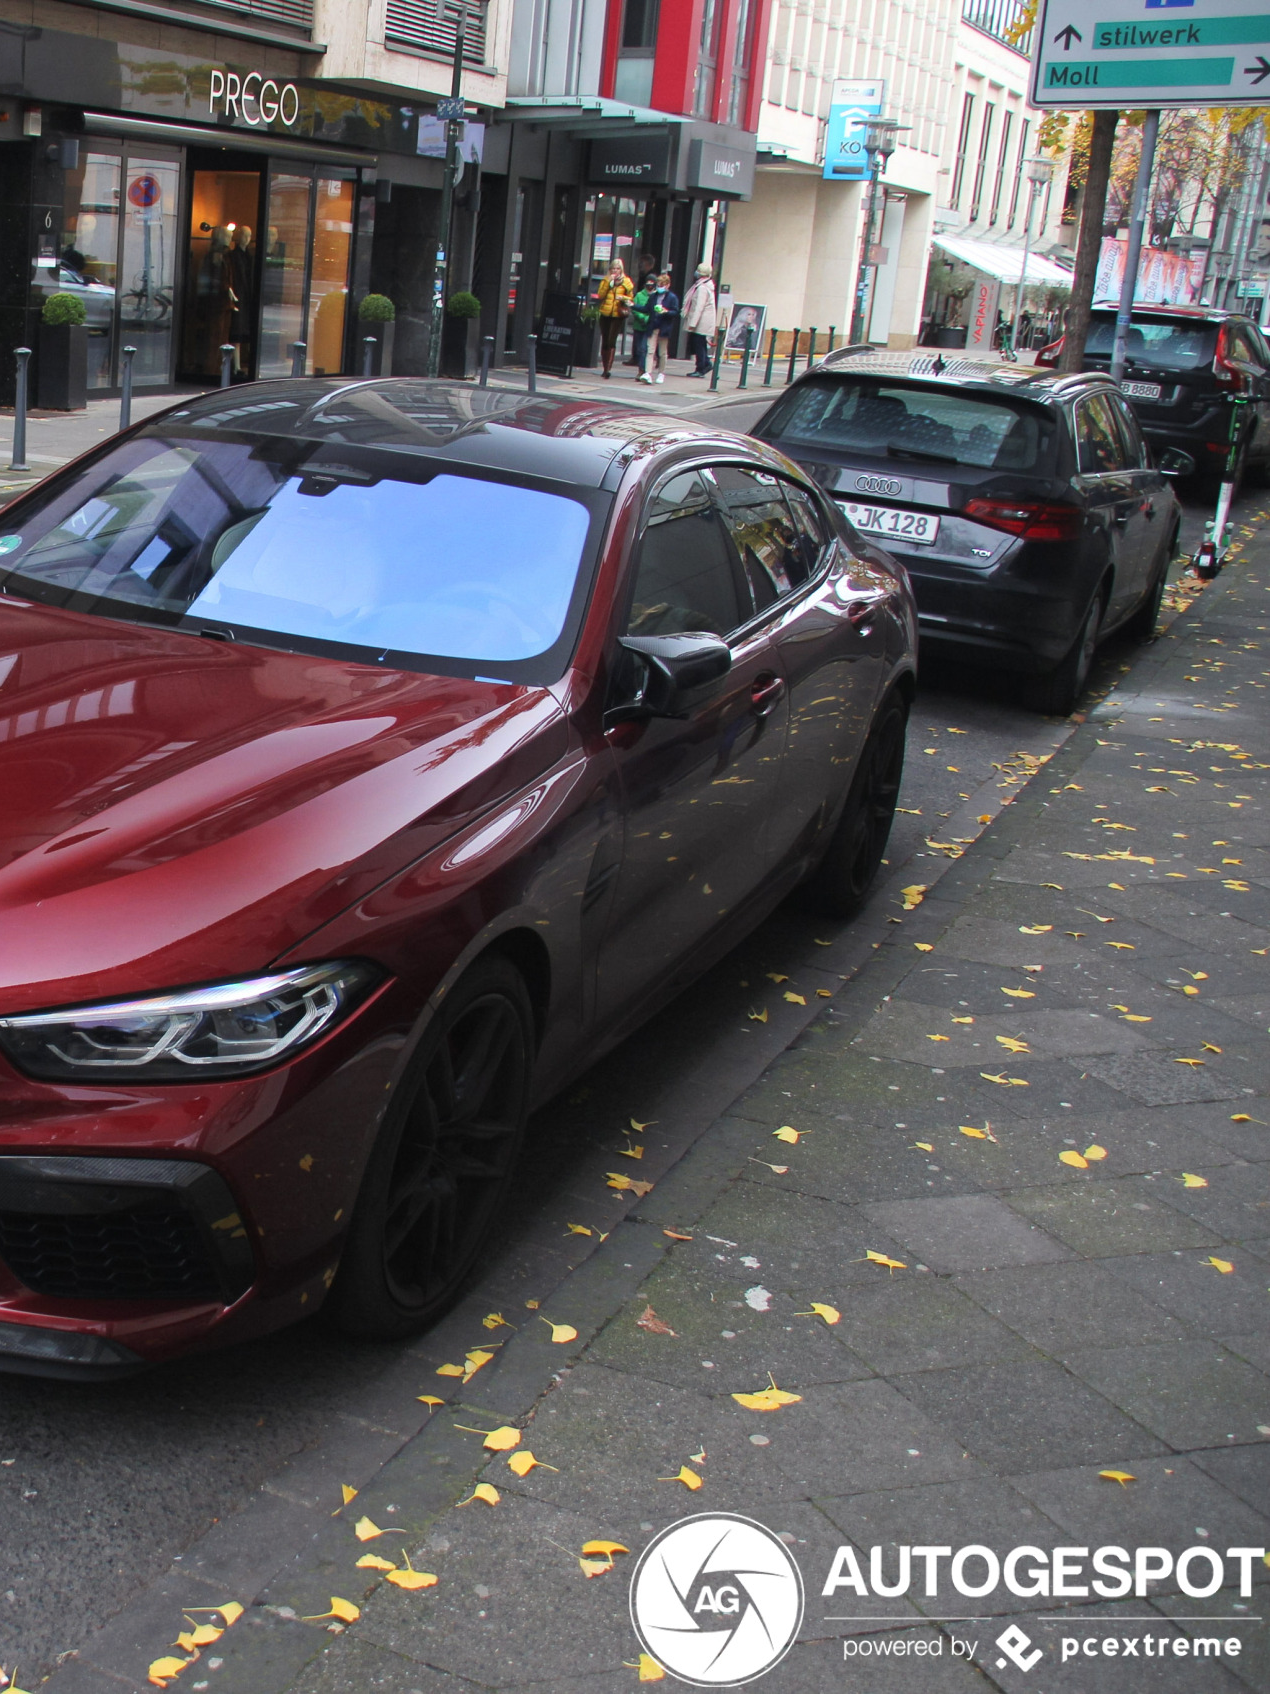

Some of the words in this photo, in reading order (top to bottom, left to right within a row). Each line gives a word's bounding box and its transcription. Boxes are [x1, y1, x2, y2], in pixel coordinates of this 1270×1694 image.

[1099, 24, 1201, 46] stilwerk
[1049, 66, 1098, 86] Moll
[209, 69, 299, 126] PREGO
[605, 164, 642, 175] LUMAS
[714, 159, 735, 178] LUMAS
[44, 210, 52, 229] 6
[971, 285, 989, 344] VAPIANO
[857, 508, 886, 530] JK
[888, 512, 928, 536] 128
